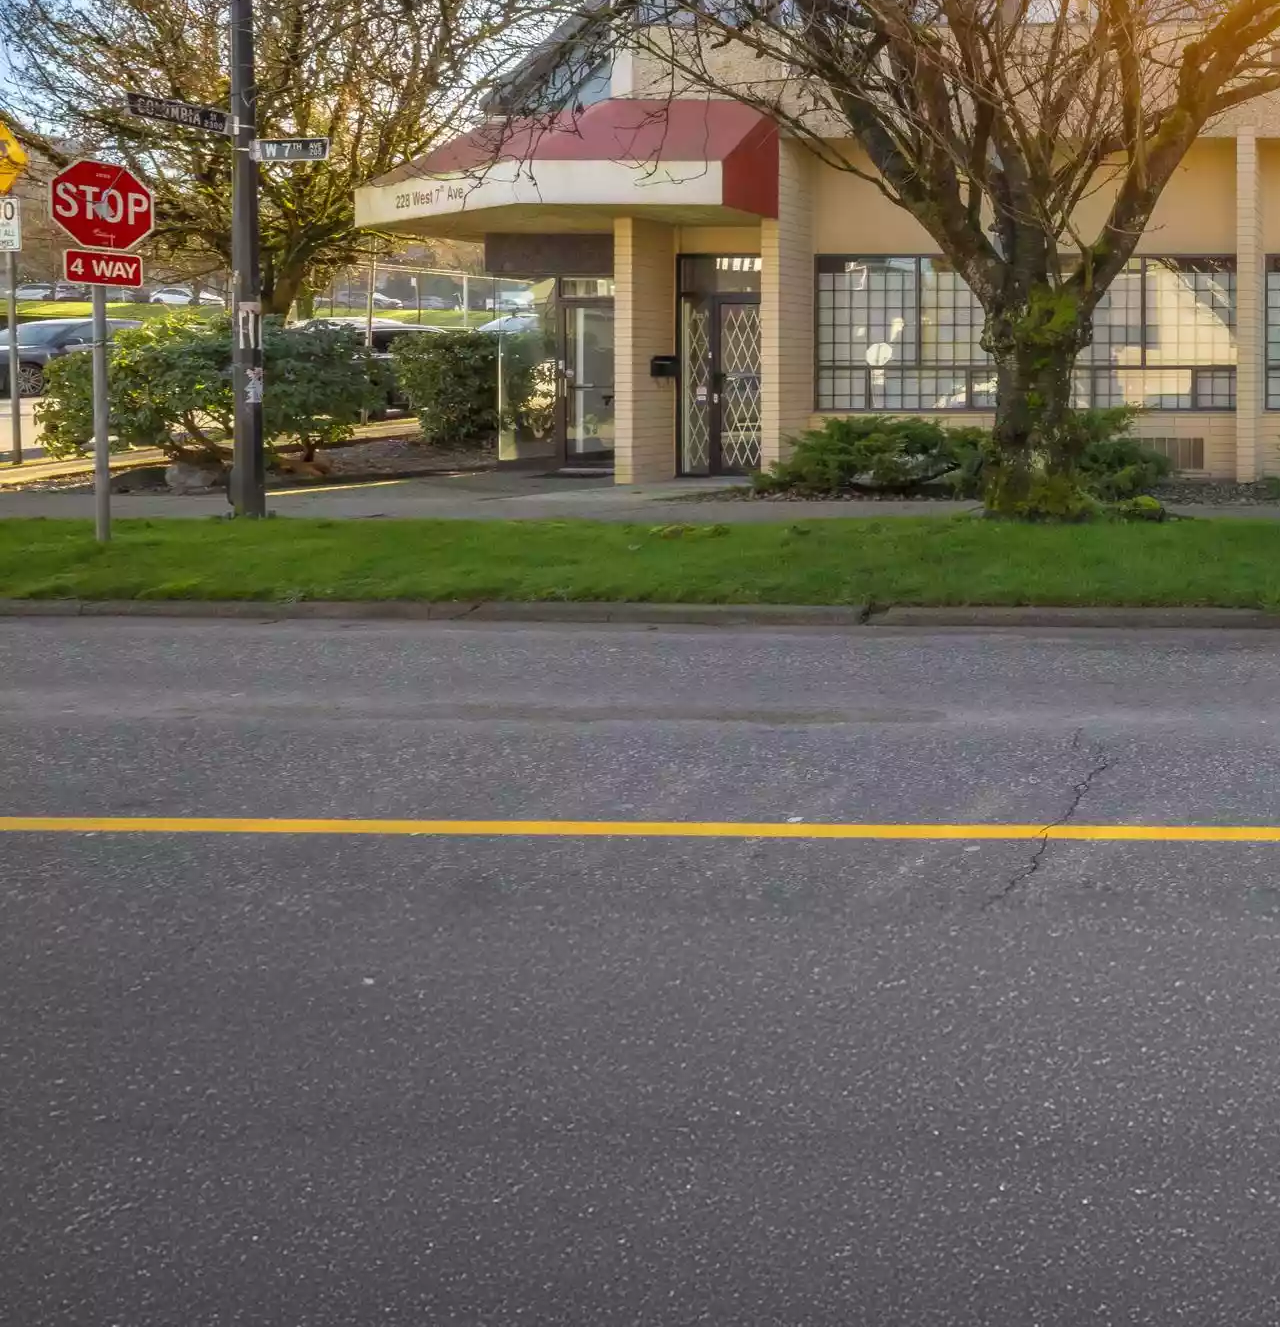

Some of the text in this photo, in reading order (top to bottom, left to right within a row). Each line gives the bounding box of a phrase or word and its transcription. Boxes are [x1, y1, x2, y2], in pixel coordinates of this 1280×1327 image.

[265, 143, 277, 158] W
[55, 181, 149, 225] STOP
[396, 192, 411, 209] 228
[412, 190, 433, 206] West
[447, 185, 464, 201] Ave
[70, 258, 138, 279] 4 WAY
